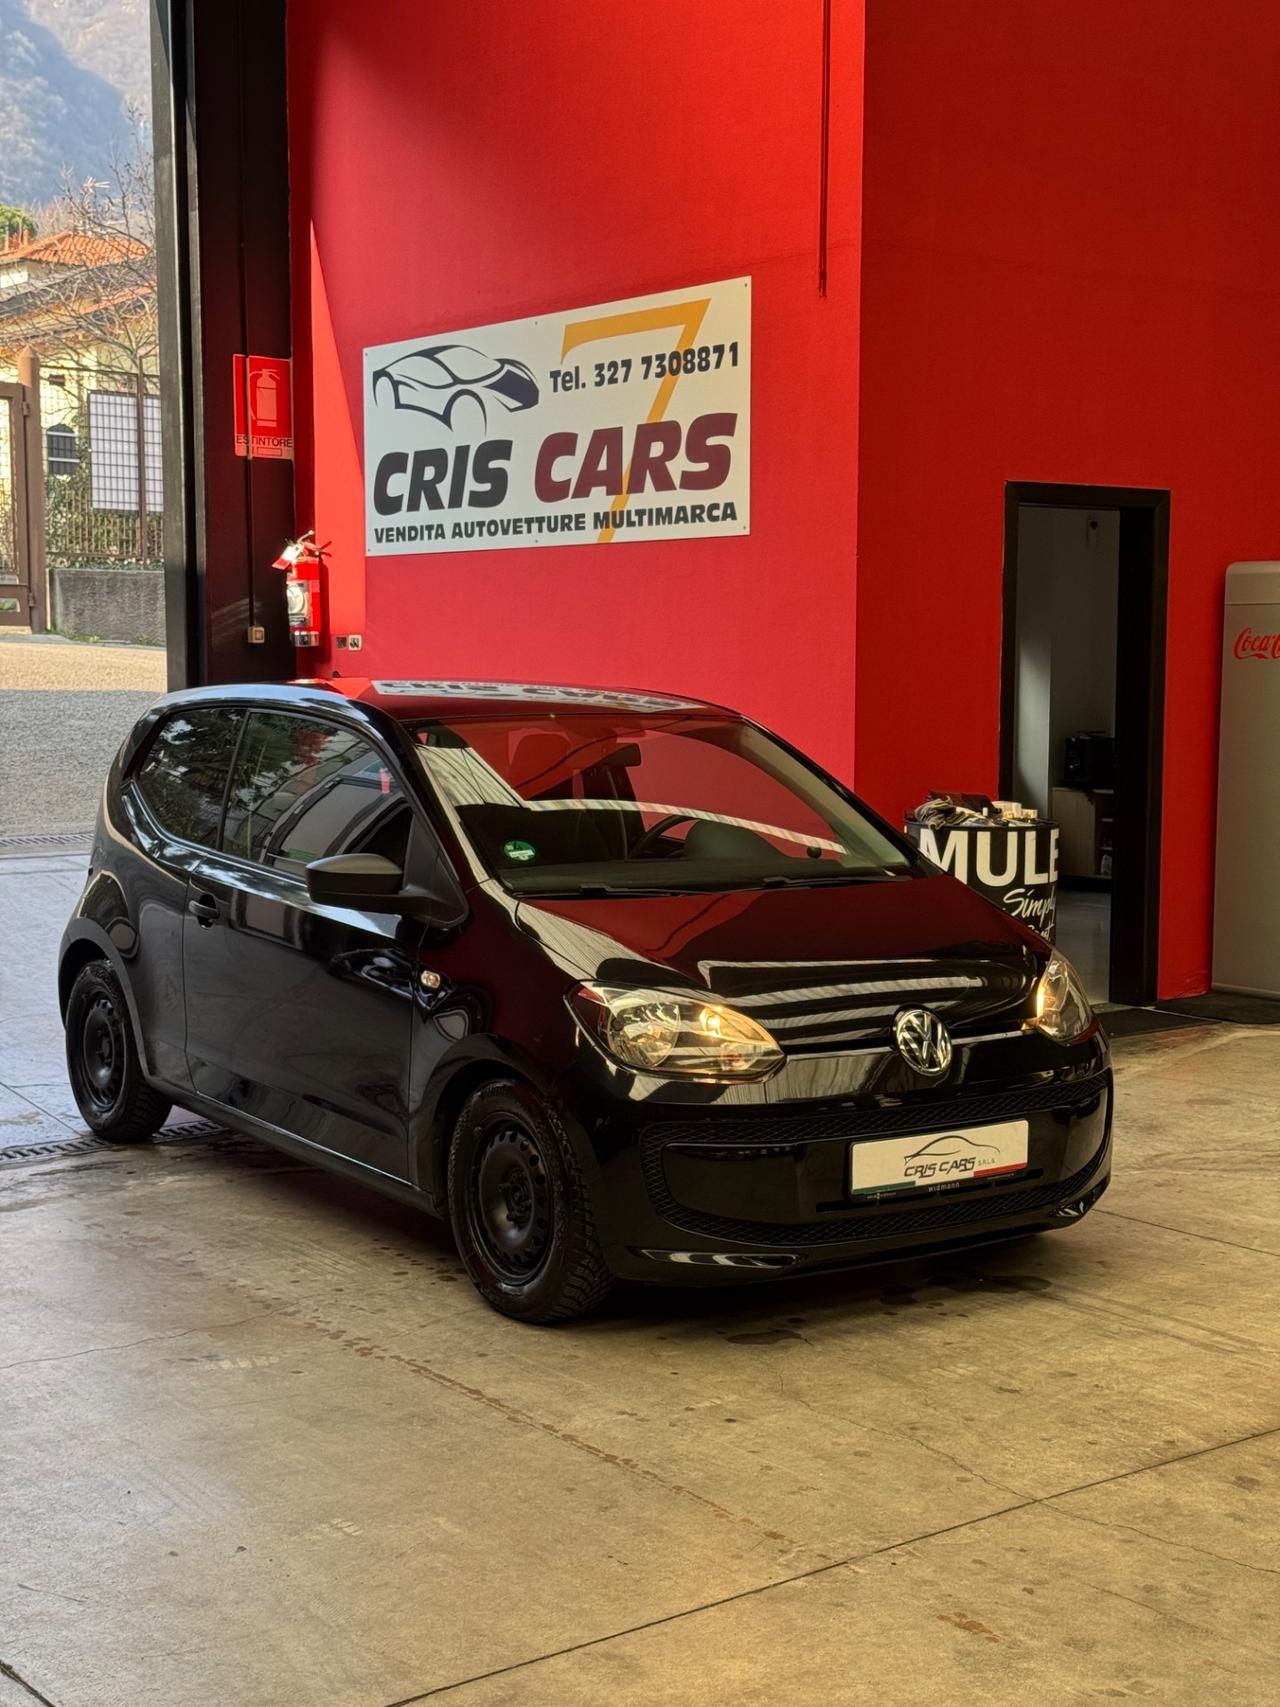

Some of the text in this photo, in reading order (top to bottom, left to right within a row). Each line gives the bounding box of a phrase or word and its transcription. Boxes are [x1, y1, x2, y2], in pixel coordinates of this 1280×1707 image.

[549, 341, 739, 393] Tel. 327 7308871
[236, 434, 293, 448] ESTINTORE
[373, 412, 738, 516] CRIS CARS
[374, 501, 738, 544] VENDITA AUTOVETTURE MULTIMARCA
[918, 828, 1060, 887] MULE
[904, 1163, 937, 1179] CRIS
[938, 1157, 976, 1175] CARS
[928, 1182, 960, 1193] widmann
